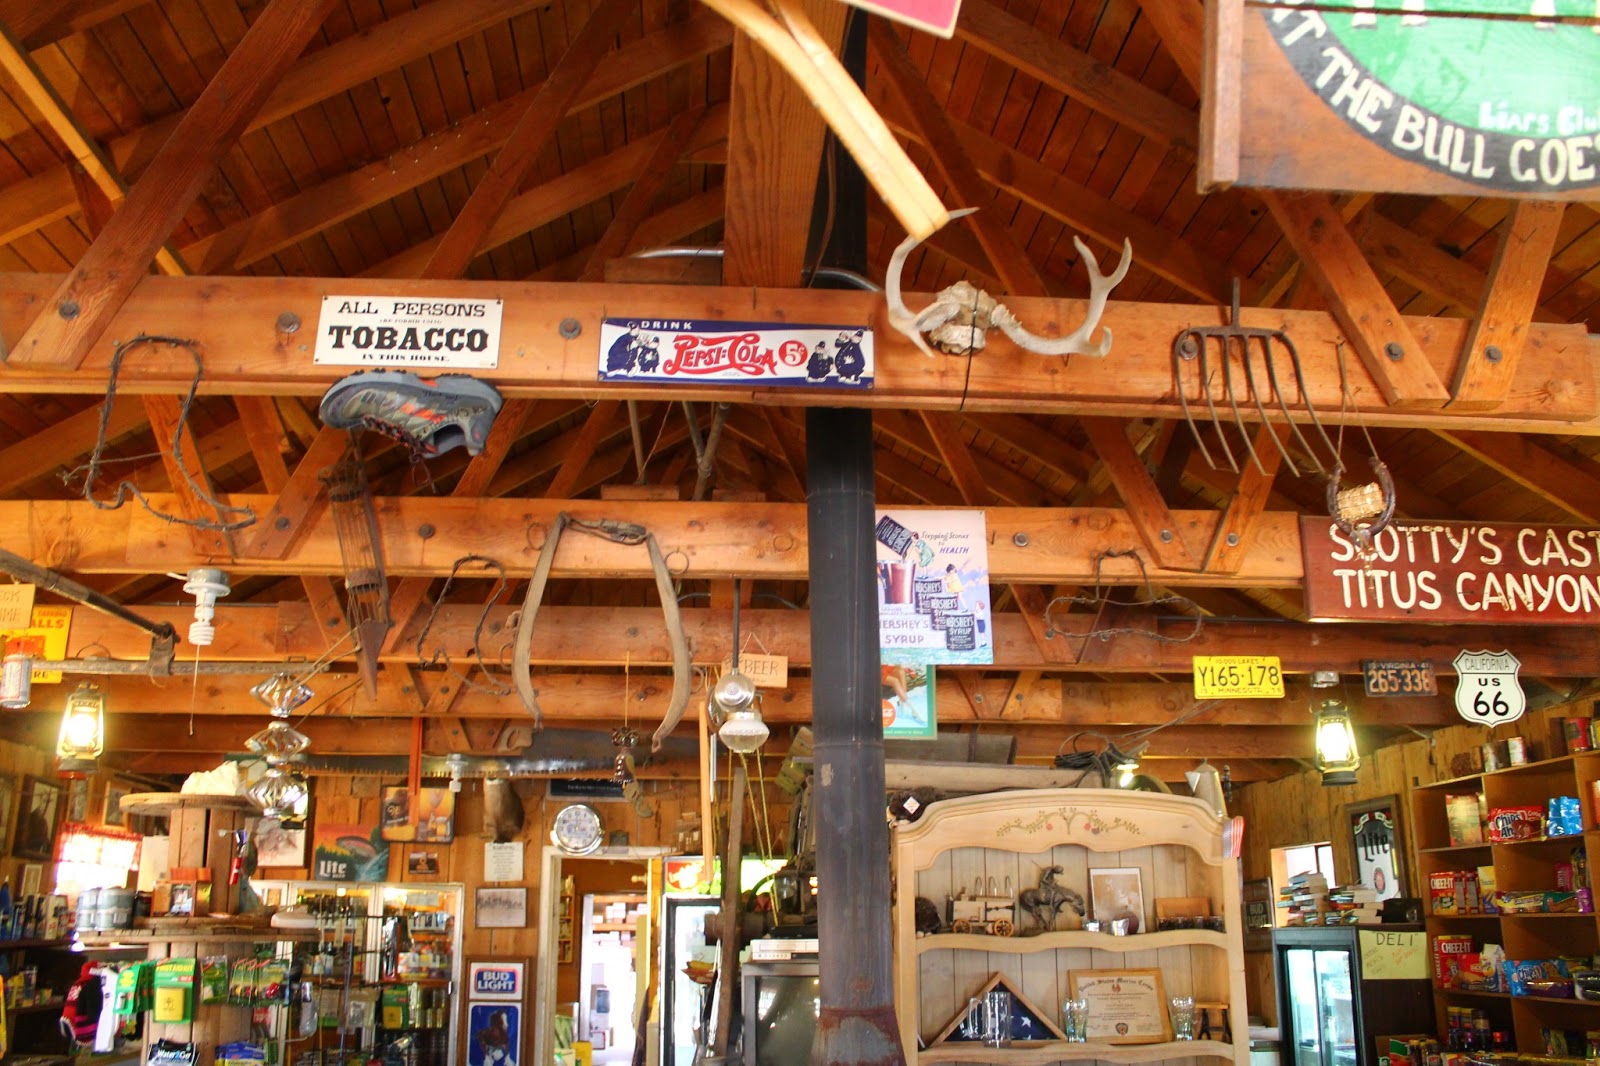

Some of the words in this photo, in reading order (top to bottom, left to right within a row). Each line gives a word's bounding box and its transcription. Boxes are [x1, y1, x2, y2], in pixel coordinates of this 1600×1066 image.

[1315, 46, 1394, 134] THE
[1391, 104, 1496, 179] BULL
[1508, 133, 1600, 187] GOE
[1478, 101, 1550, 133] Liars
[1556, 105, 1600, 136] Clu
[338, 301, 379, 314] ALL
[392, 302, 486, 317] PERSONS
[641, 320, 693, 330] DRINK
[328, 325, 489, 352] TOBACCO
[939, 546, 970, 554] HEALTH
[1332, 569, 1443, 610] TITUS
[1456, 571, 1600, 613] CANYON
[885, 635, 925, 644] SYRUP
[743, 659, 779, 676] BEER
[1464, 657, 1511, 672] CALIFORNIA
[1477, 677, 1502, 688] US
[1473, 690, 1510, 718] 66
[1362, 832, 1389, 863] Lite
[319, 860, 347, 878] Lite
[1441, 941, 1471, 955] CHEEZ-IT
[483, 971, 511, 981] BUD
[477, 980, 515, 991] LIGHT
